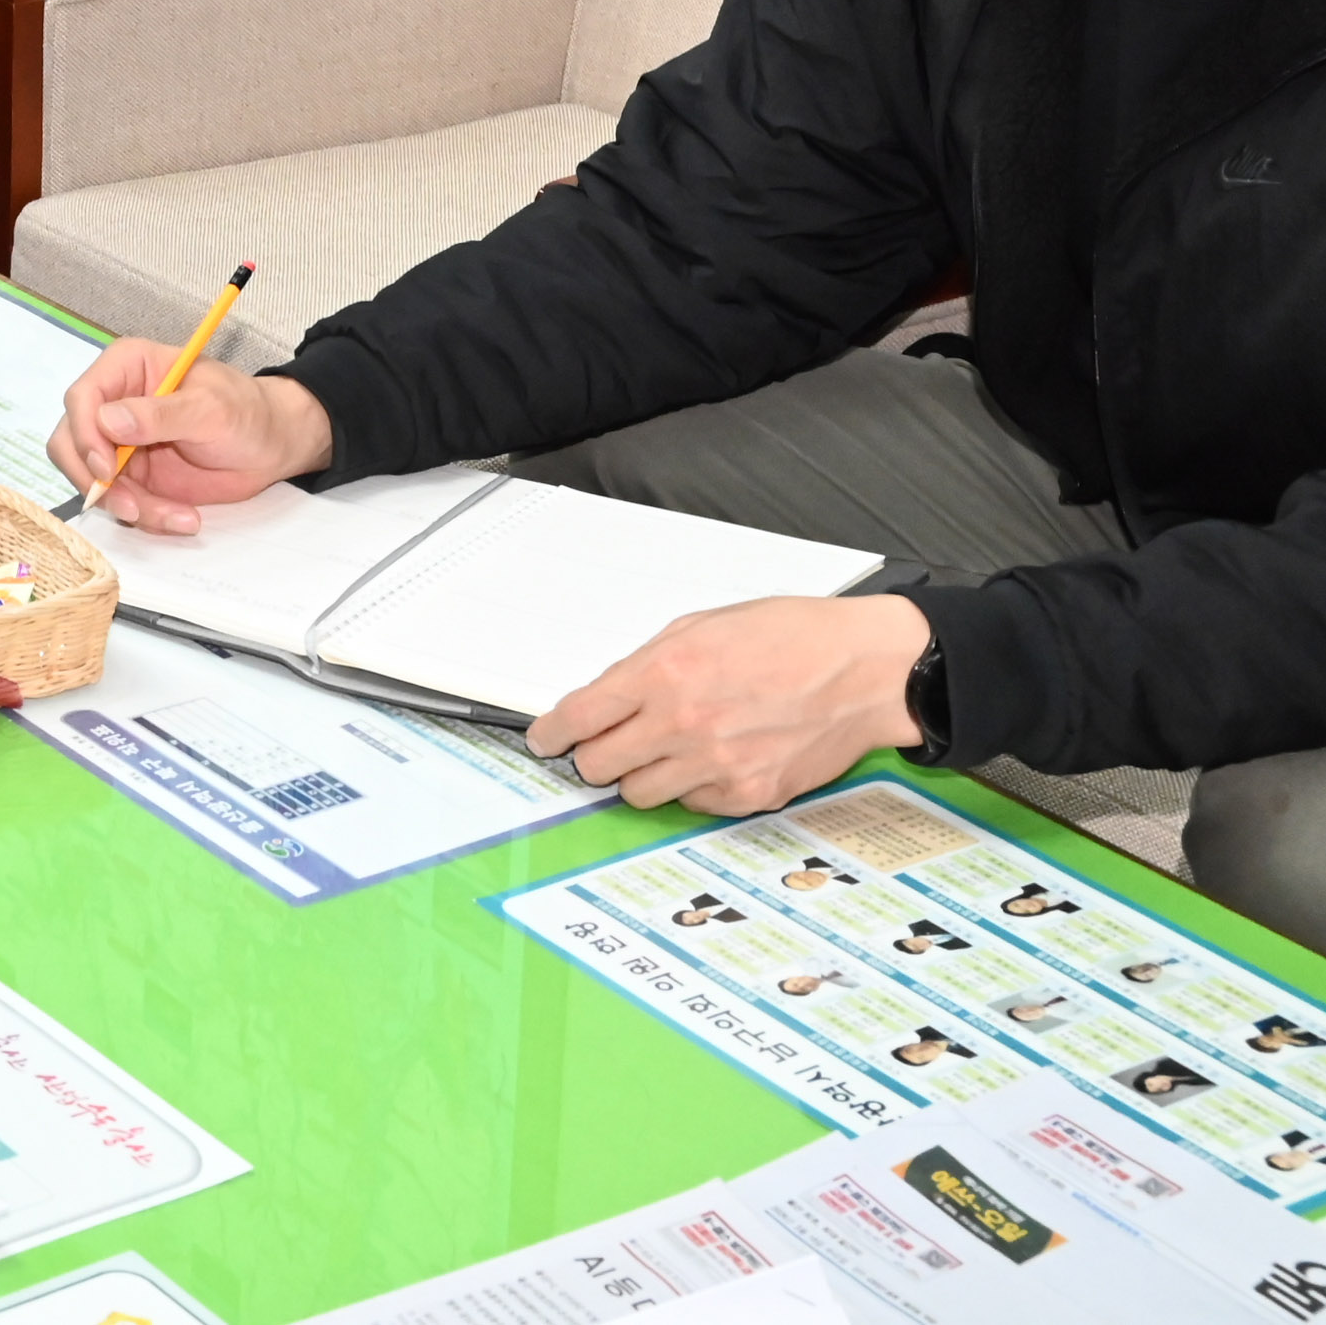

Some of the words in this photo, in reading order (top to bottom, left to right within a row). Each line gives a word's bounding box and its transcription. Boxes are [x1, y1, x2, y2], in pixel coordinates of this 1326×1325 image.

[563, 920, 628, 958] 현황
[621, 956, 686, 995] 의원
[680, 992, 798, 1064] 남구의회
